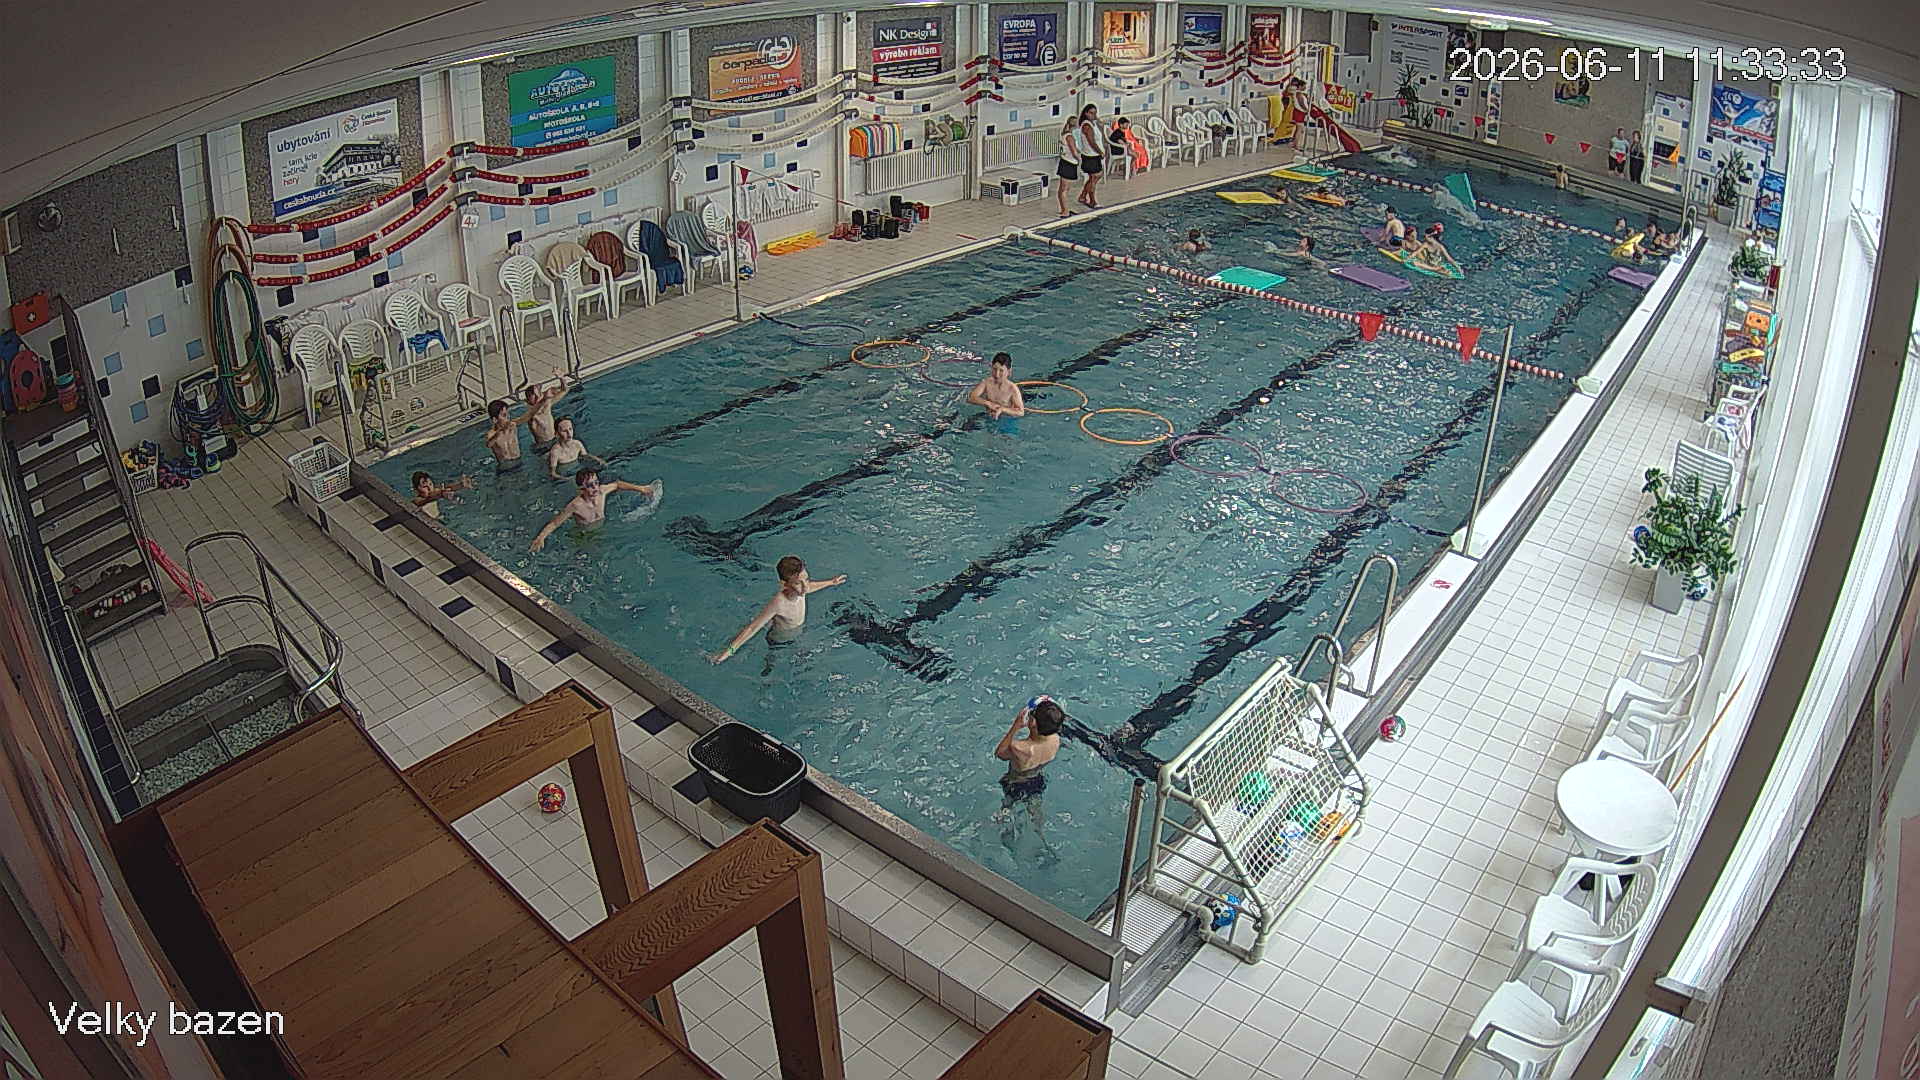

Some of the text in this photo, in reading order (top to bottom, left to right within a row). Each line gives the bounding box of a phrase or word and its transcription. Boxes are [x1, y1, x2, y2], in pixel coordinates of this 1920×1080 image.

[1003, 19, 1036, 29] EVROPA
[880, 28, 930, 41] NK Design
[909, 46, 937, 56] reklam
[277, 128, 331, 153] ubytování
[282, 176, 300, 187] hory
